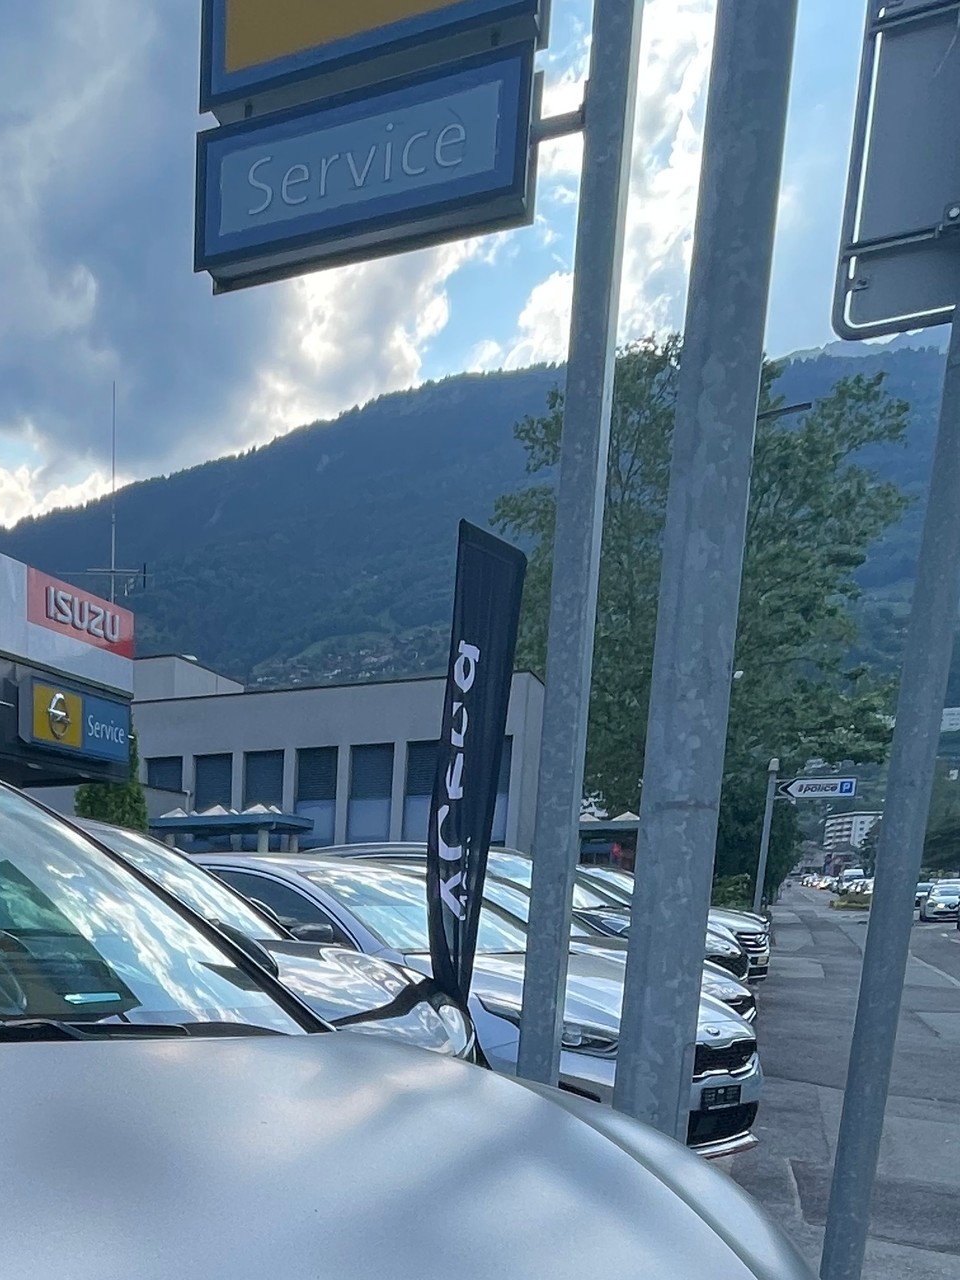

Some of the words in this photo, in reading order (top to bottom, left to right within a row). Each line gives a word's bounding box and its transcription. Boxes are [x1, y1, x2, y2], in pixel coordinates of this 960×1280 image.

[247, 121, 467, 217] Service
[46, 585, 121, 644] ISUZU
[87, 714, 125, 745] Service
